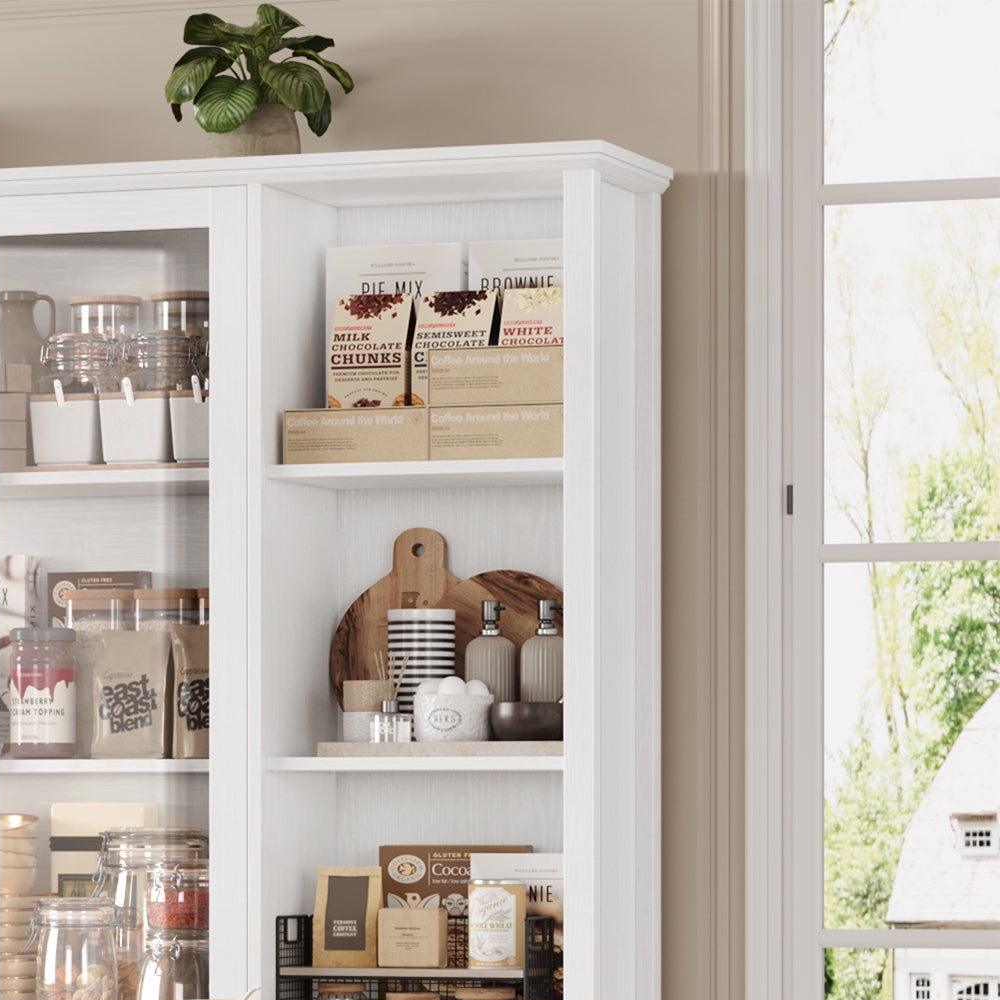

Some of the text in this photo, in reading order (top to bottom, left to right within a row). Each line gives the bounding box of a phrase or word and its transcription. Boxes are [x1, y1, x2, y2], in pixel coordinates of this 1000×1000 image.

[394, 280, 423, 300] MIX
[332, 332, 371, 342] MILK
[416, 329, 487, 340] SEMISWEET
[502, 326, 553, 336] WHITE
[331, 342, 402, 351] CHOCOLATE
[414, 339, 486, 349] CHOCOLATE
[330, 352, 402, 366] CHUNKS
[431, 355, 463, 366] Coffee
[465, 353, 500, 365] Around
[502, 353, 520, 363] the
[520, 351, 550, 363] World
[287, 414, 404, 428] Coffee Around the World
[431, 410, 550, 424] Coffee Around the World
[101, 674, 149, 701] east
[99, 688, 158, 720] coast
[34, 708, 65, 716] TOPPING
[110, 709, 152, 734] blend
